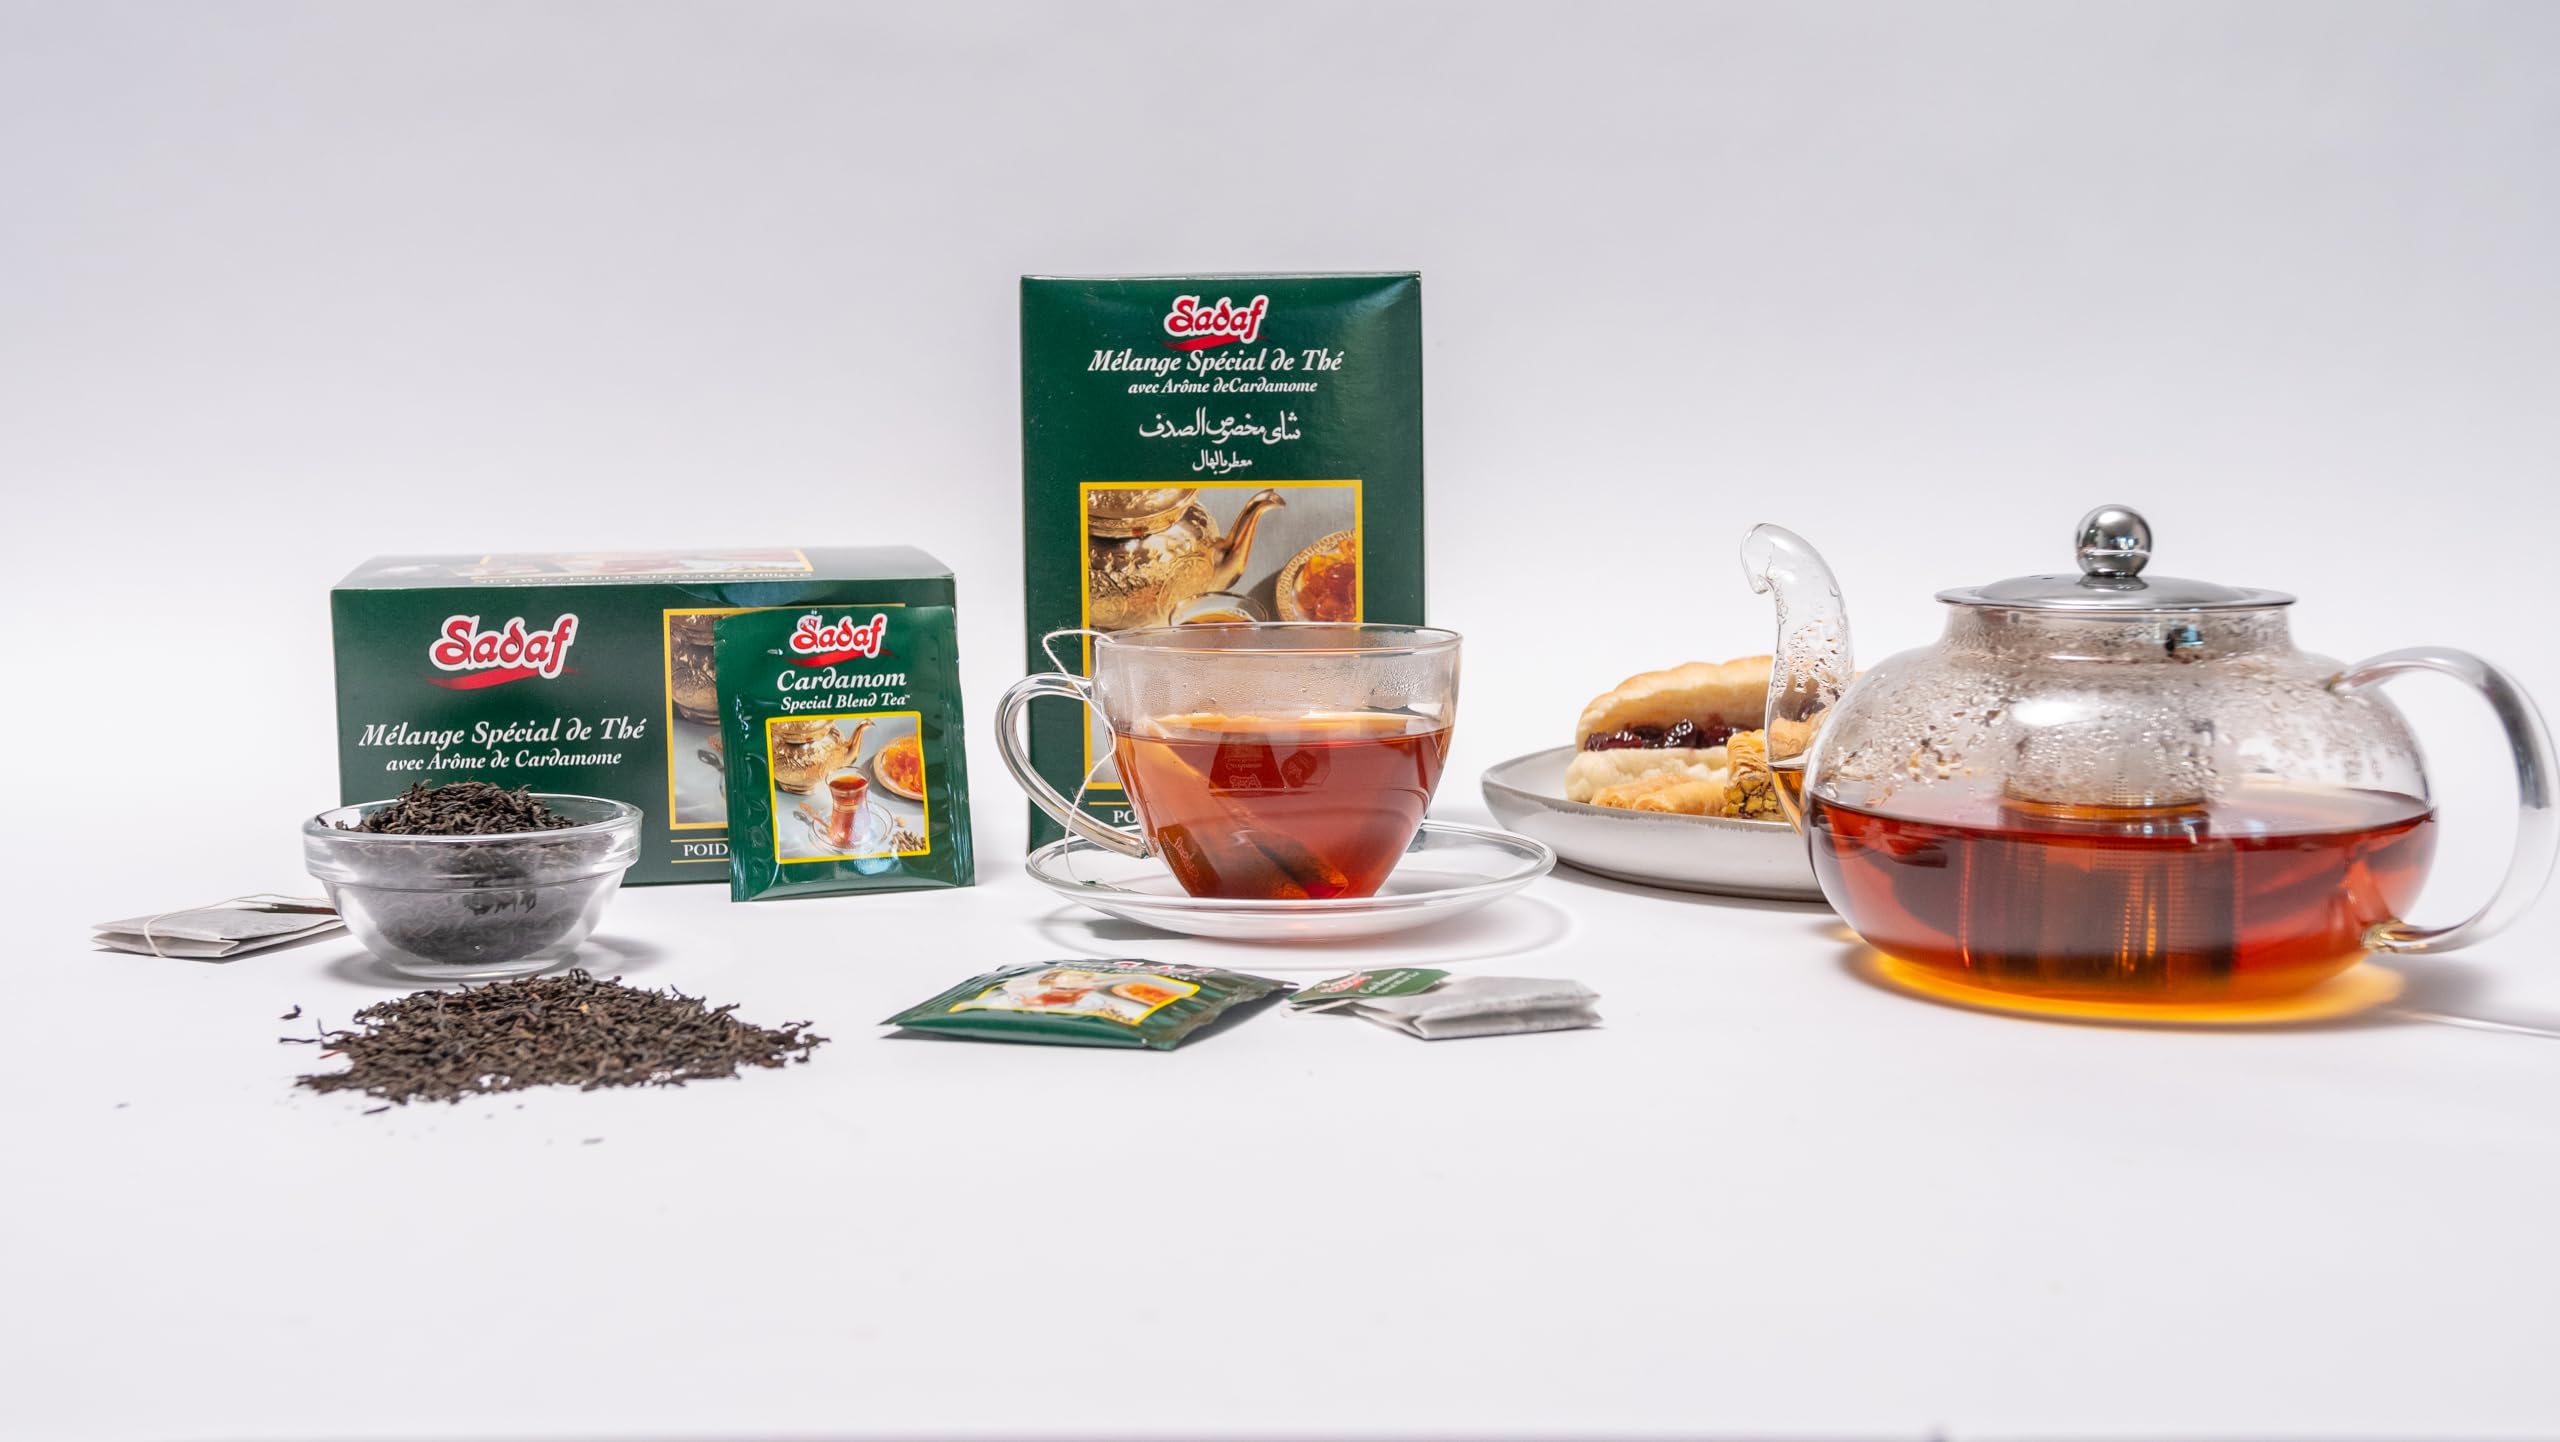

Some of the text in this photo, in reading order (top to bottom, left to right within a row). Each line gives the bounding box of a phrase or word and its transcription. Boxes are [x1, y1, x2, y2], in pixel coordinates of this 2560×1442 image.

[1164, 295, 1269, 344] Sadaf
[1088, 348, 1345, 377] Mélange Spécial de Thé
[1128, 382, 1159, 394] avec
[1161, 378, 1210, 394] Arôme
[1138, 406, 1206, 438] الصدف
[429, 613, 579, 679] Sadaf
[789, 613, 888, 659] Sadaf
[776, 666, 907, 692] Cardamom
[780, 693, 833, 714] Special
[835, 692, 878, 709] Blend
[358, 716, 648, 751] Mélange Spécial de Thé
[386, 747, 622, 772] avec Arôme de Cardamome
